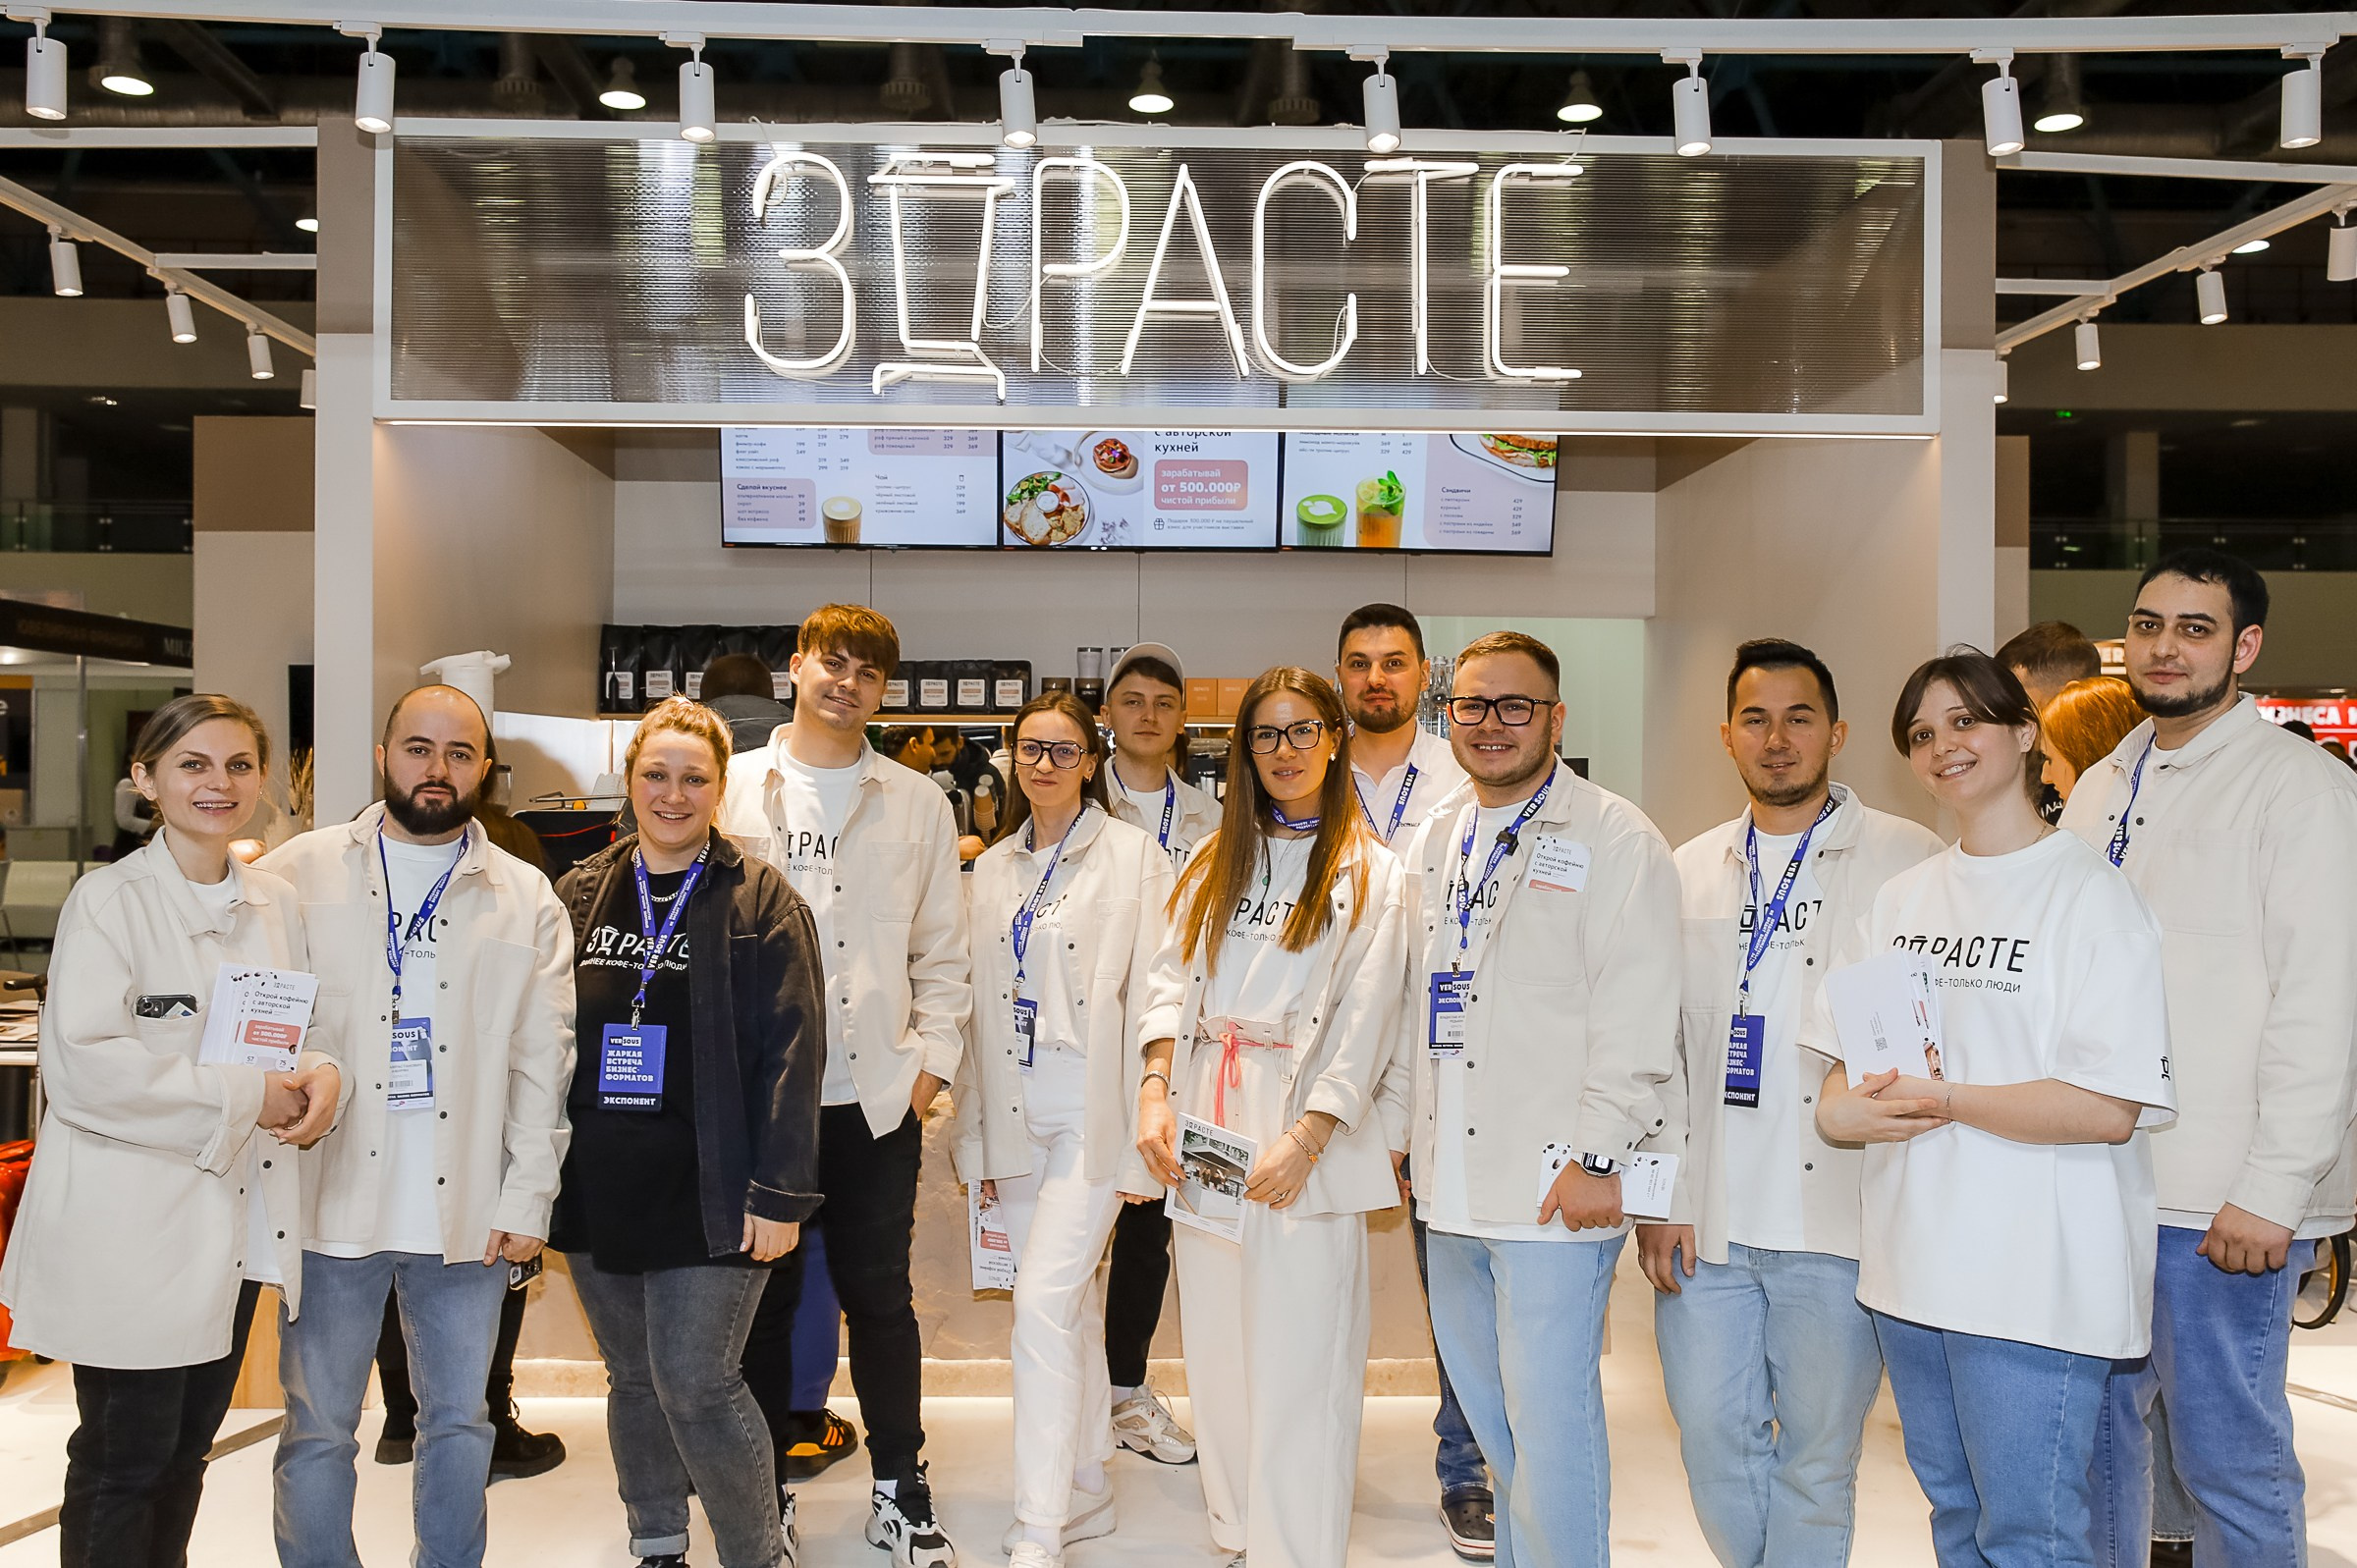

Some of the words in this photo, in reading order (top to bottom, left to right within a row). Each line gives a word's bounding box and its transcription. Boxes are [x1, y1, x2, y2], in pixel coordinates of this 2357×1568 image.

[1154, 441, 1199, 456] кухней
[1161, 468, 1221, 479] зарабатывай
[1161, 484, 1177, 493] от
[1161, 496, 1193, 505] чистой
[1194, 496, 1236, 507] прибыли
[2257, 705, 2342, 726] ИЗНЕСА
[1398, 786, 1410, 805] SOUS
[1522, 802, 1538, 818] VER
[1535, 784, 1552, 805] SOUS
[1536, 852, 1557, 862] Открой
[1557, 858, 1584, 869] кофейню
[793, 864, 833, 875] КОФЕ-ТОЛ
[1538, 862, 1567, 872] авторской
[1784, 861, 1799, 879] VER
[1776, 877, 1791, 901] SOUS
[1233, 897, 1295, 927] РАСТ
[585, 925, 689, 958] ЗДРАТЕ
[647, 952, 659, 969] VER
[653, 934, 668, 954] SOUS
[1935, 978, 1983, 988] ФЕ-ТОЛЬКО
[1985, 979, 2021, 994] ЛЮДИ
[254, 991, 279, 1000] Открой
[279, 995, 309, 1004] кофейню
[257, 1000, 291, 1009] авторской
[607, 1050, 643, 1058] ЖАРКАЯ
[606, 1057, 643, 1066] ВСТРЕЧА
[605, 1065, 640, 1074] БИЗНЕС-
[1727, 1067, 1755, 1076] ОРМАТОВ
[605, 1073, 654, 1082] ФОРМАТОВ
[603, 1096, 657, 1106] ЭКСПОНЕНТ
[1724, 1091, 1756, 1102] КСПОНЕНТ
